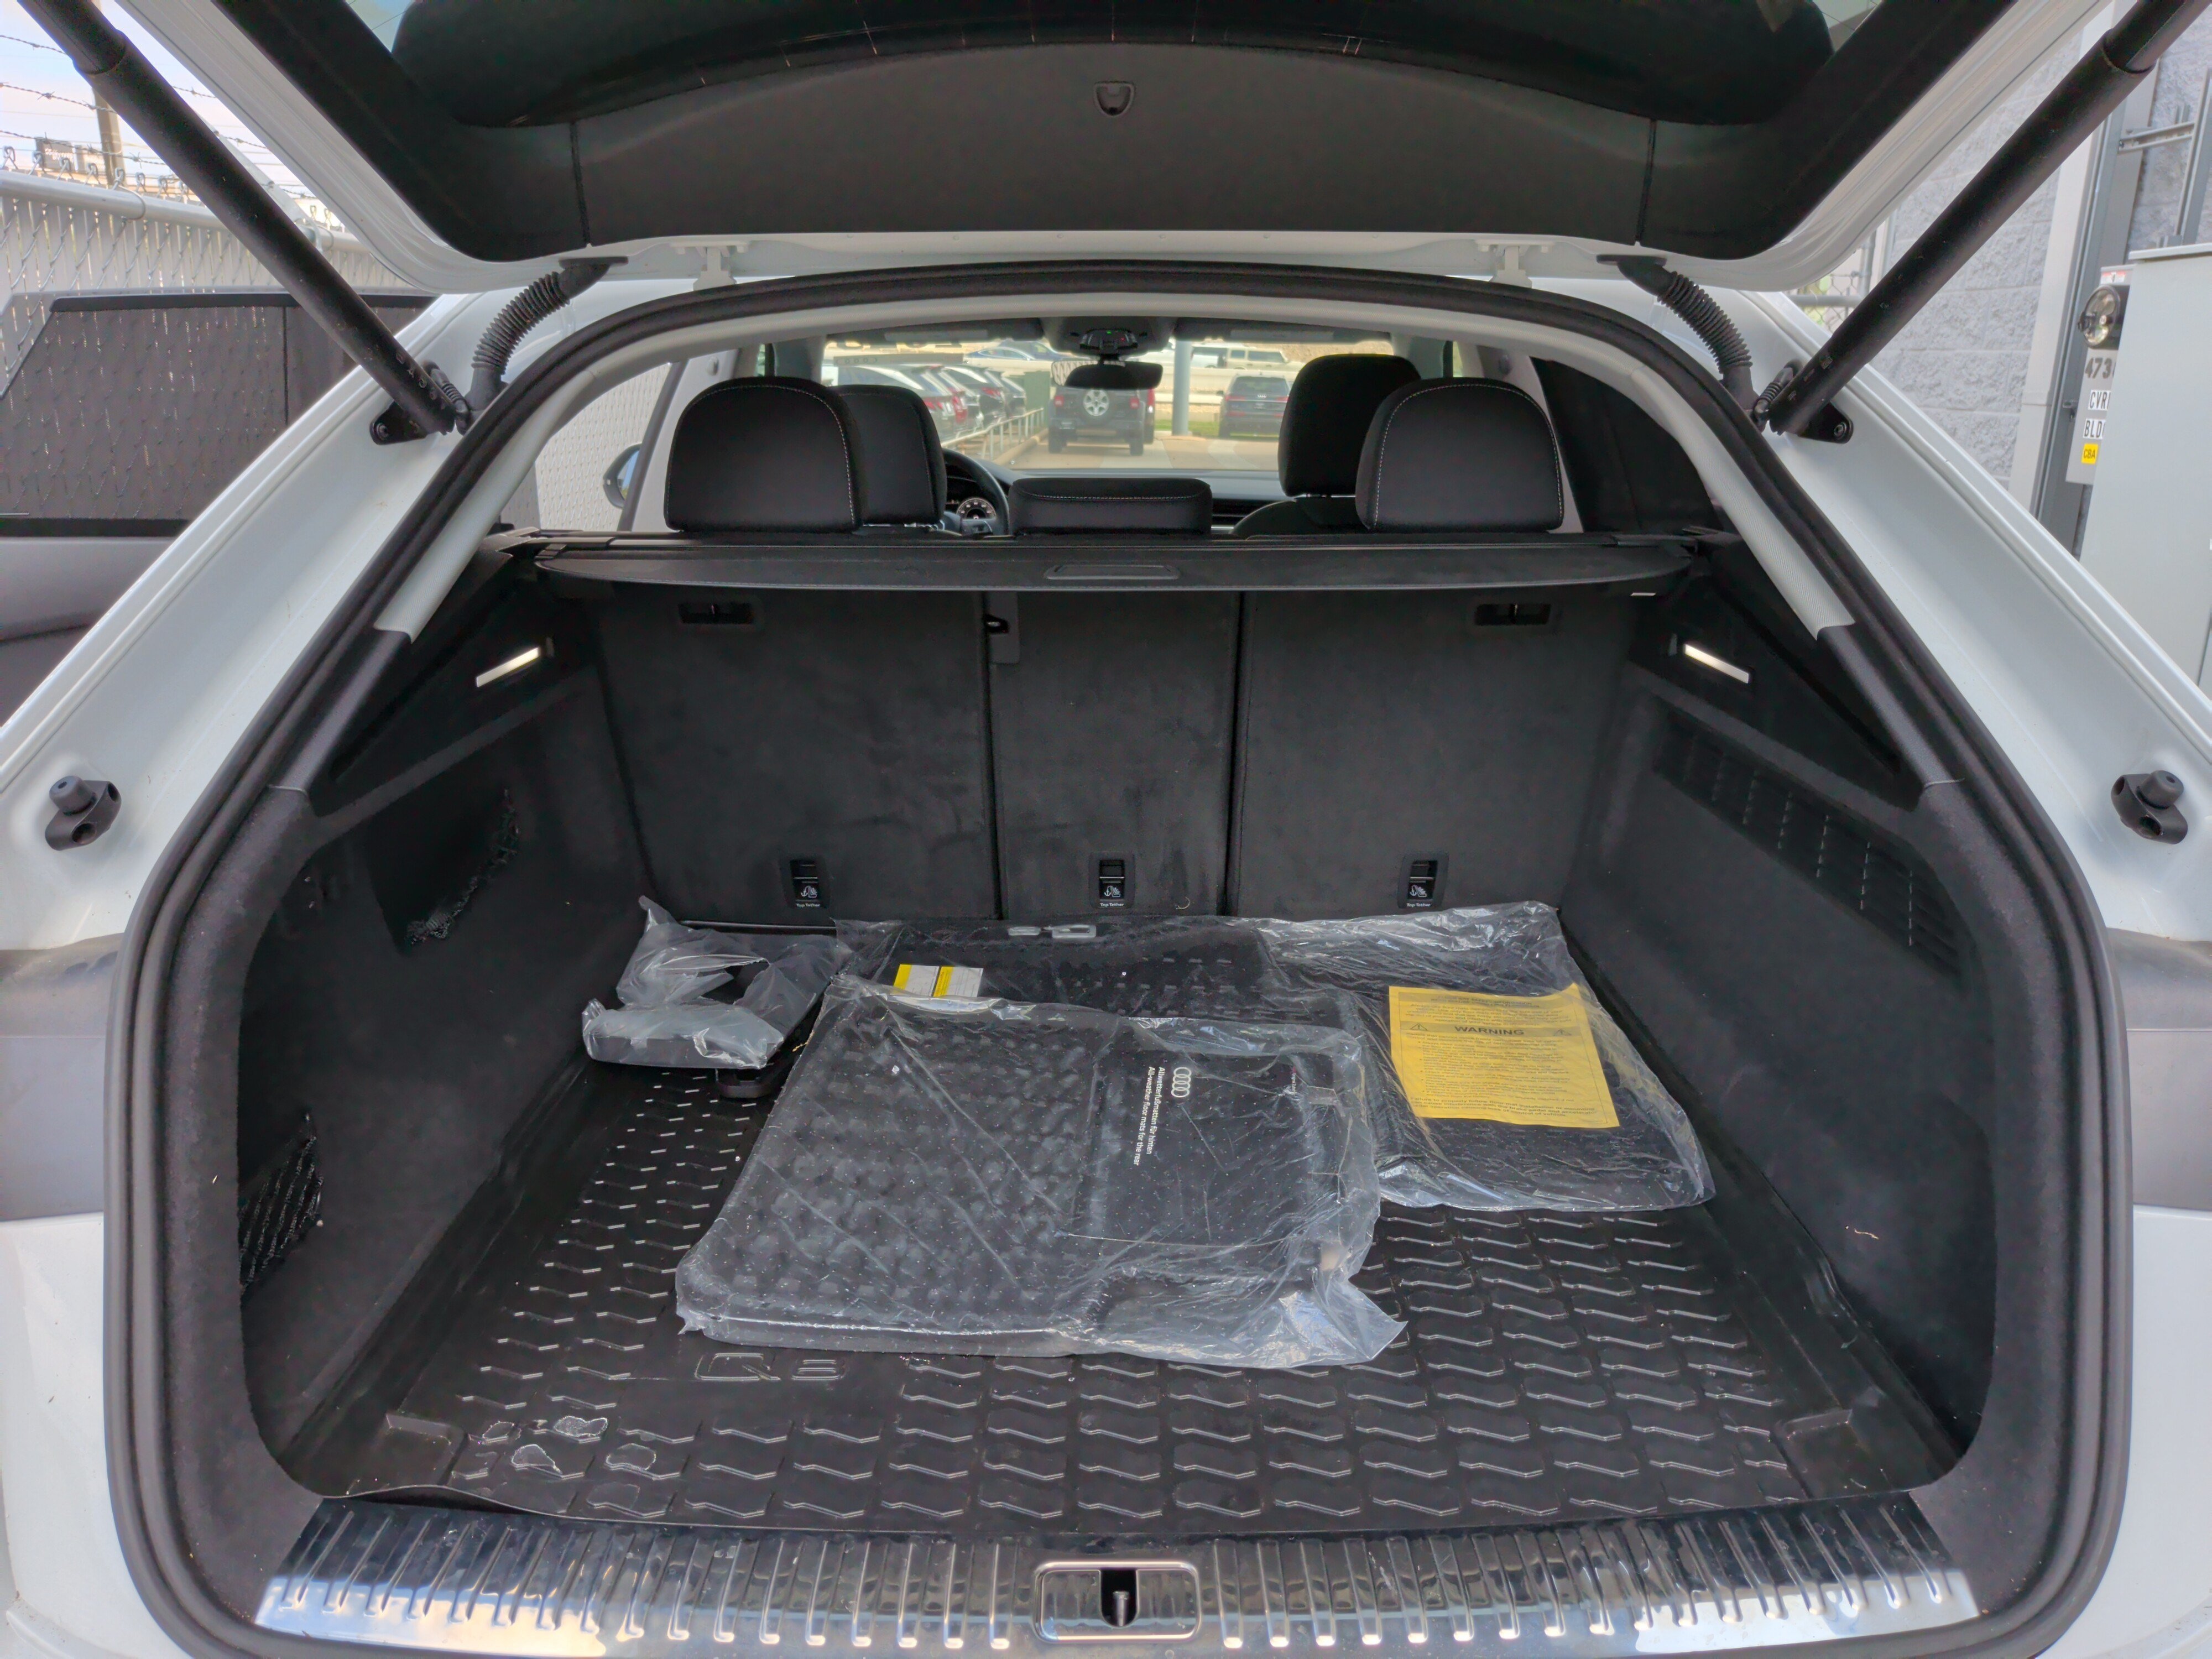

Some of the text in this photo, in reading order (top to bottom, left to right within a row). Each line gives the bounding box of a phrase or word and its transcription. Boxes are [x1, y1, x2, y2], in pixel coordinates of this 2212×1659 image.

[2085, 358, 2116, 379] 473
[2089, 391, 2111, 409] CVR
[2084, 420, 2105, 438] BLD
[2083, 448, 2096, 459] CBA
[1454, 1026, 1525, 1035] WARNING
[1144, 1066, 1156, 1101] All-weather
[1141, 1102, 1151, 1116] floor
[1146, 1067, 1166, 1155] Allwetterfußmatten für hinten
[1139, 1116, 1147, 1131] mats
[1138, 1131, 1146, 1141] for
[1135, 1142, 1144, 1152] the
